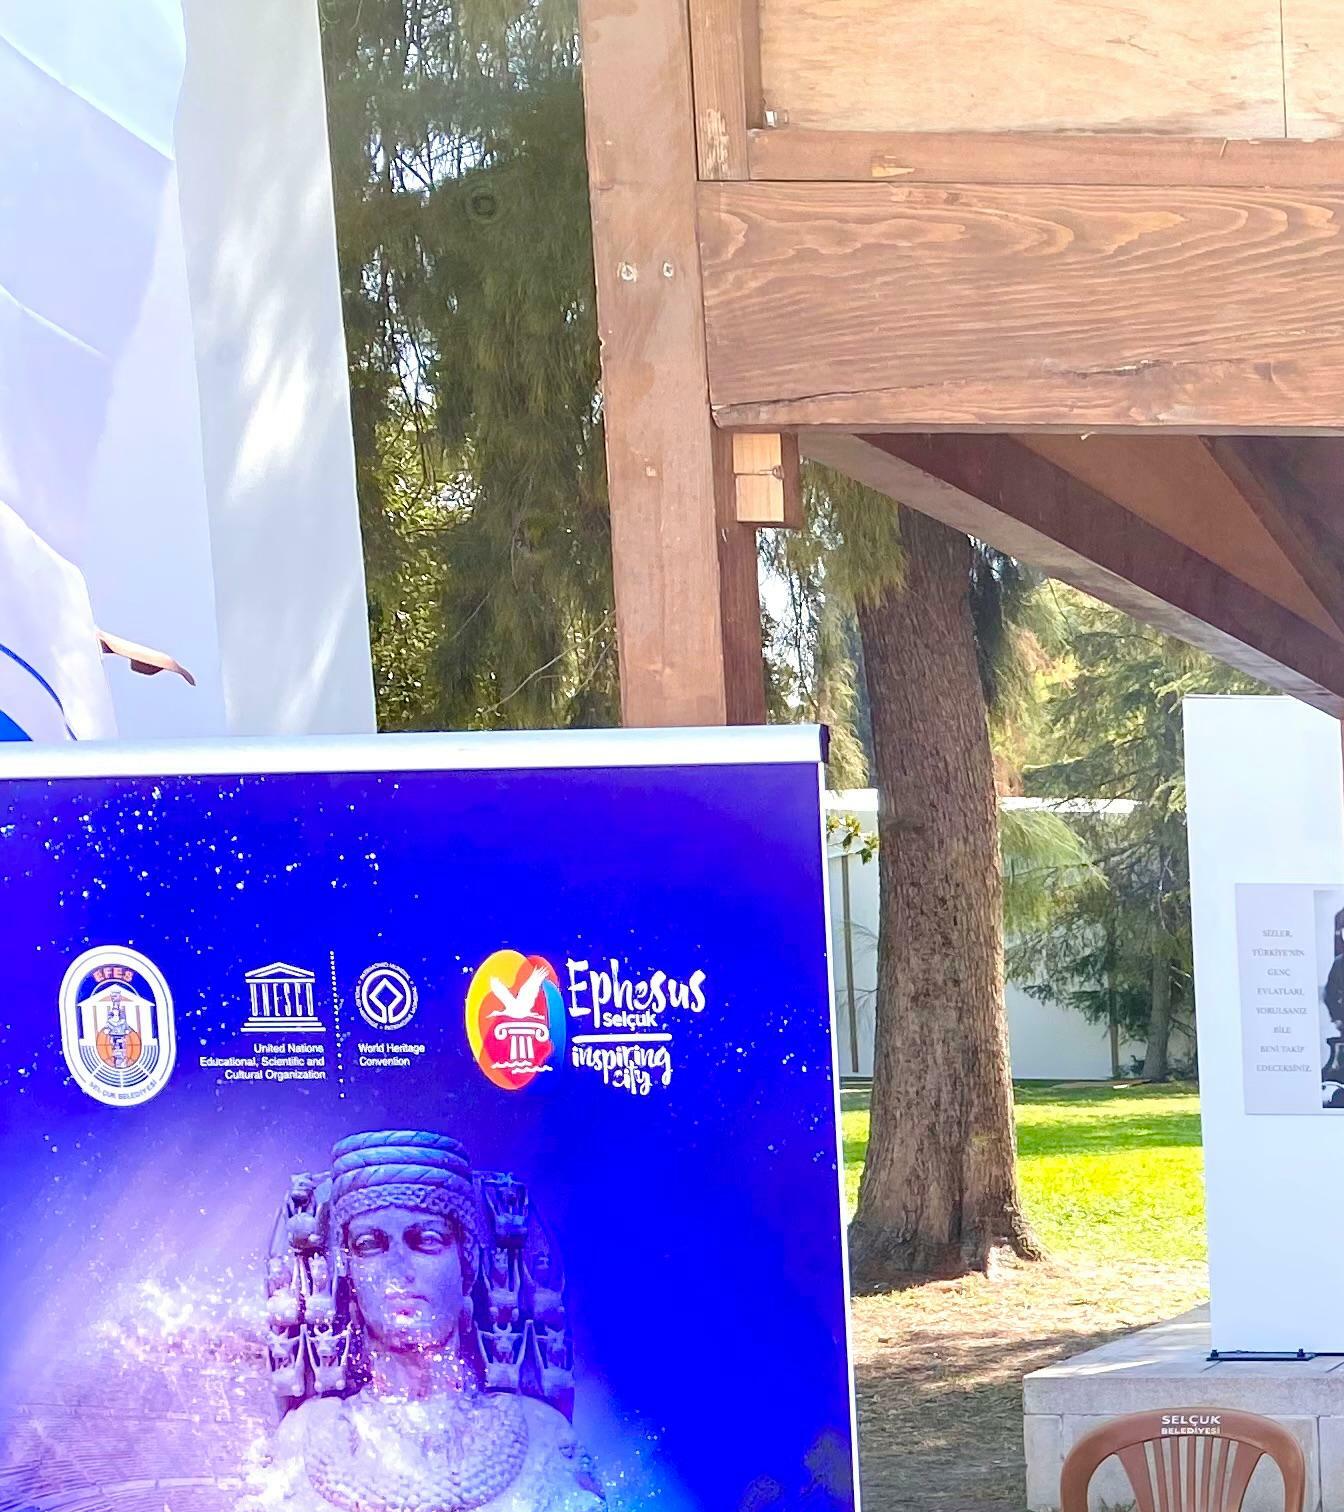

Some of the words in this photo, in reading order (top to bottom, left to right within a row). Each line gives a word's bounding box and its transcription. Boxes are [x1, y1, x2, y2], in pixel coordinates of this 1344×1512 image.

[92, 967, 134, 982] EFES
[251, 983, 315, 1017] UNESCO
[565, 958, 707, 1028] Ephesus
[602, 1011, 658, 1031] selçuk
[254, 1043, 285, 1054] United
[288, 1043, 324, 1054] Nations
[358, 1043, 385, 1054] World
[387, 1043, 425, 1055] Heritage
[199, 1056, 258, 1068] Educational,
[261, 1056, 303, 1067] Scientific
[306, 1057, 325, 1067] and
[359, 1056, 411, 1067] Convention
[572, 1045, 673, 1086] inspiring
[225, 1069, 262, 1080] Cultural
[265, 1069, 325, 1081] Organization
[612, 1060, 653, 1096] city
[1161, 1414, 1221, 1428] SELÇUK
[1161, 1426, 1221, 1435] BELEDİYESİ
